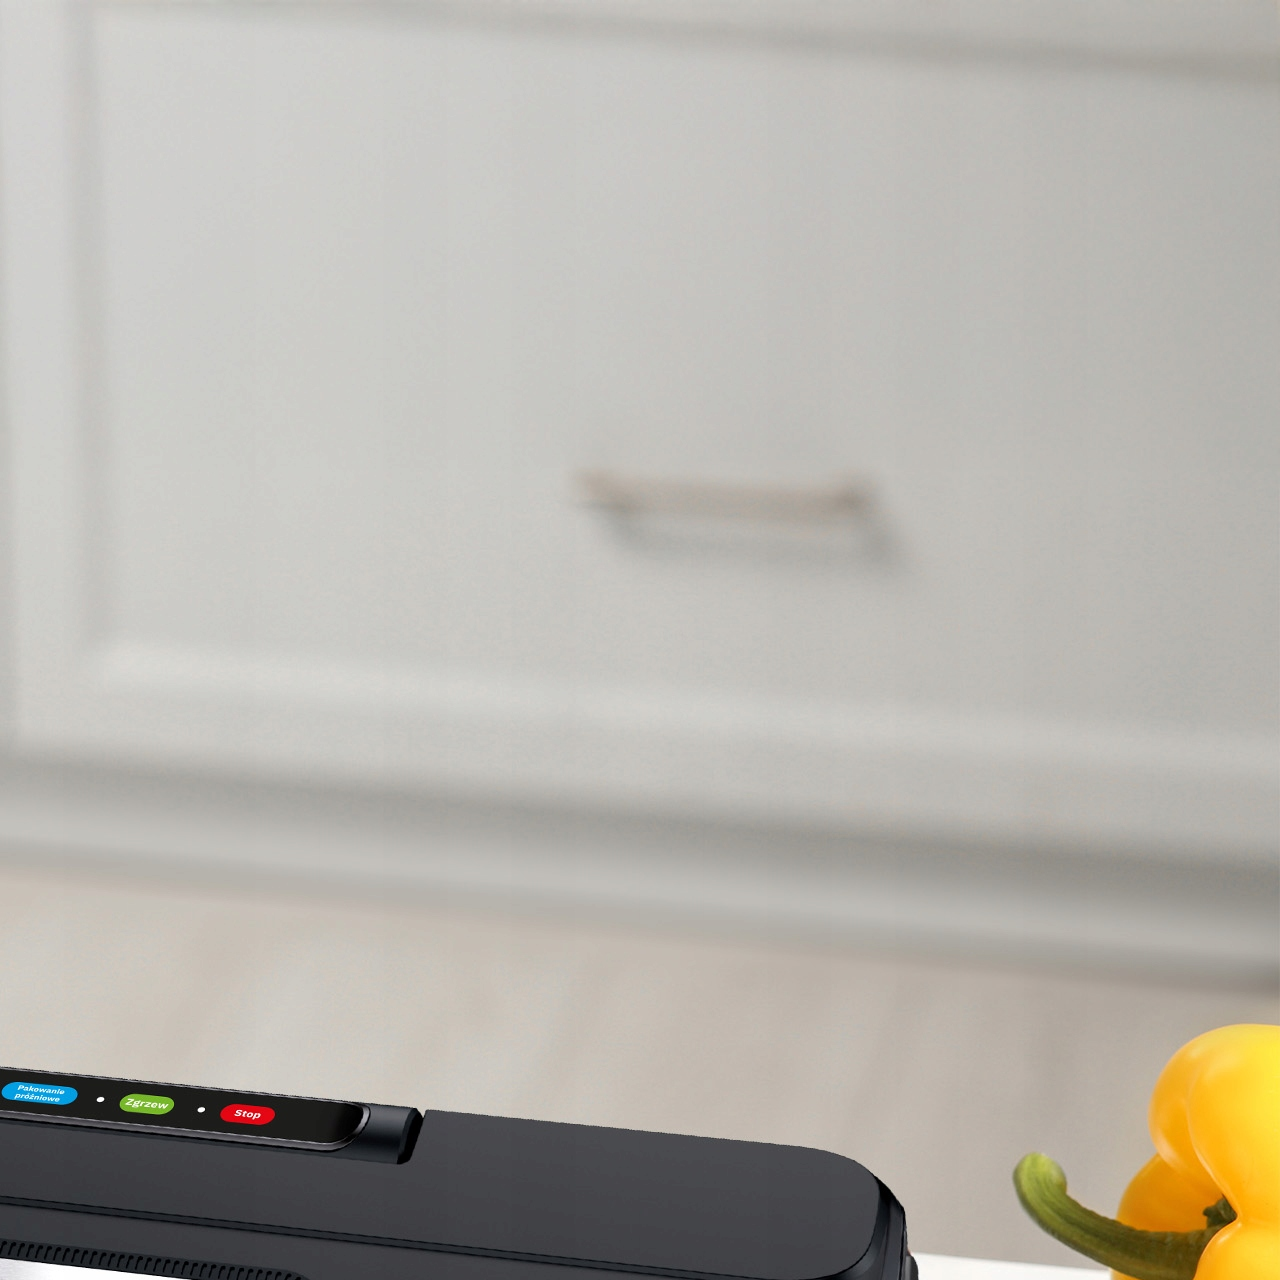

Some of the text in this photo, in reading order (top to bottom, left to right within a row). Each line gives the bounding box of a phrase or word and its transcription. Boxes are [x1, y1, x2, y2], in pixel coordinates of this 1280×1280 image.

[17, 1084, 65, 1095] Pakowanie
[125, 1098, 169, 1110] Zgrzew
[234, 1109, 262, 1120] Stop
